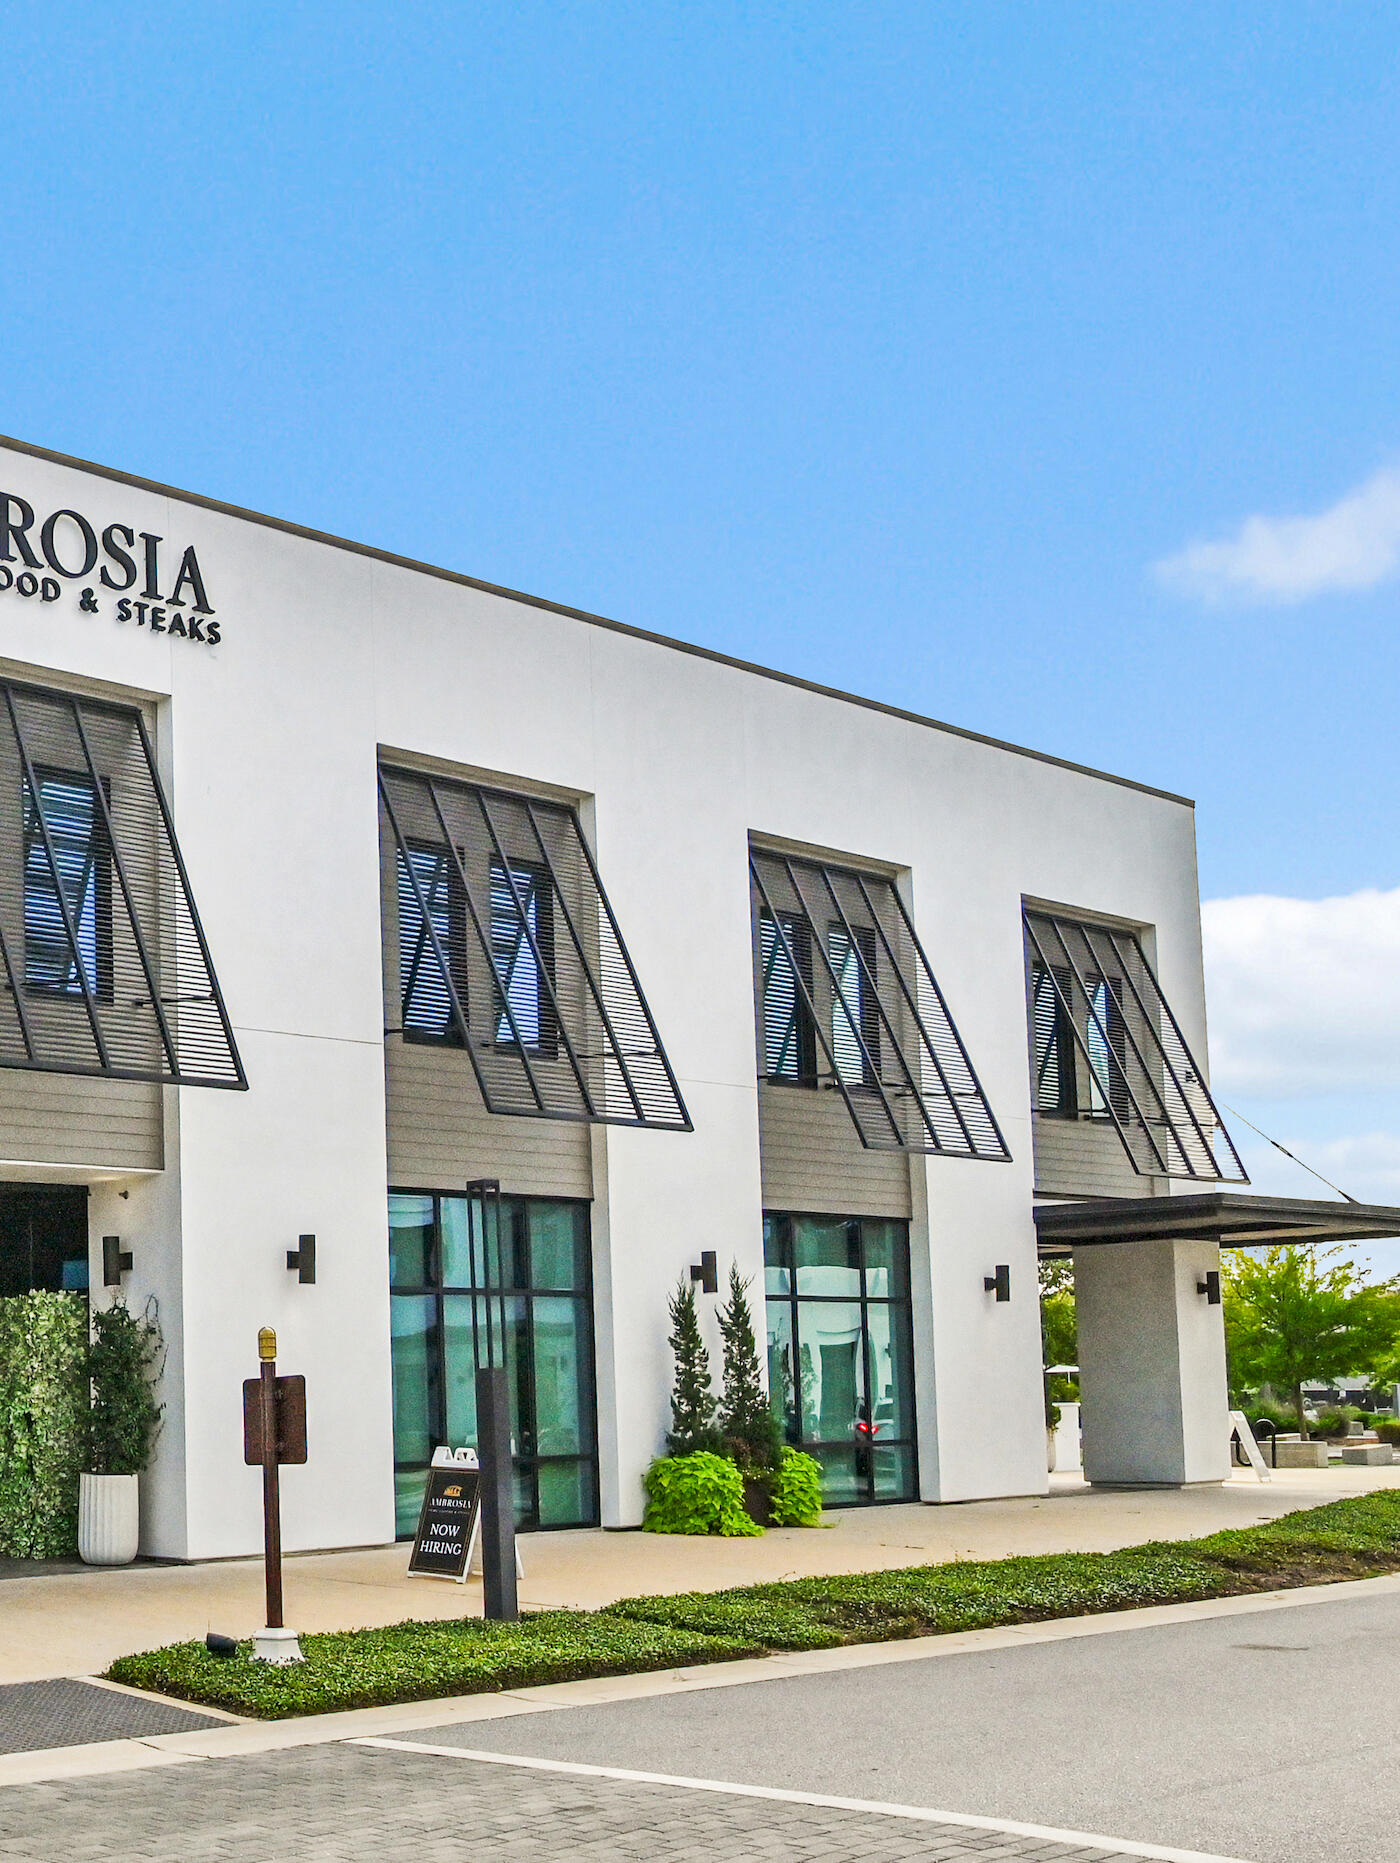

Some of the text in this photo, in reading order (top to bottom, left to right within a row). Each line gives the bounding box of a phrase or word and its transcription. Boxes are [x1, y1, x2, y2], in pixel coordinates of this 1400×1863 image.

[79, 587, 100, 614] &
[117, 597, 222, 646] STEAKS
[429, 1498, 471, 1509] AMBROSIA
[429, 1523, 461, 1537] NOW
[419, 1540, 462, 1556] HIRING
